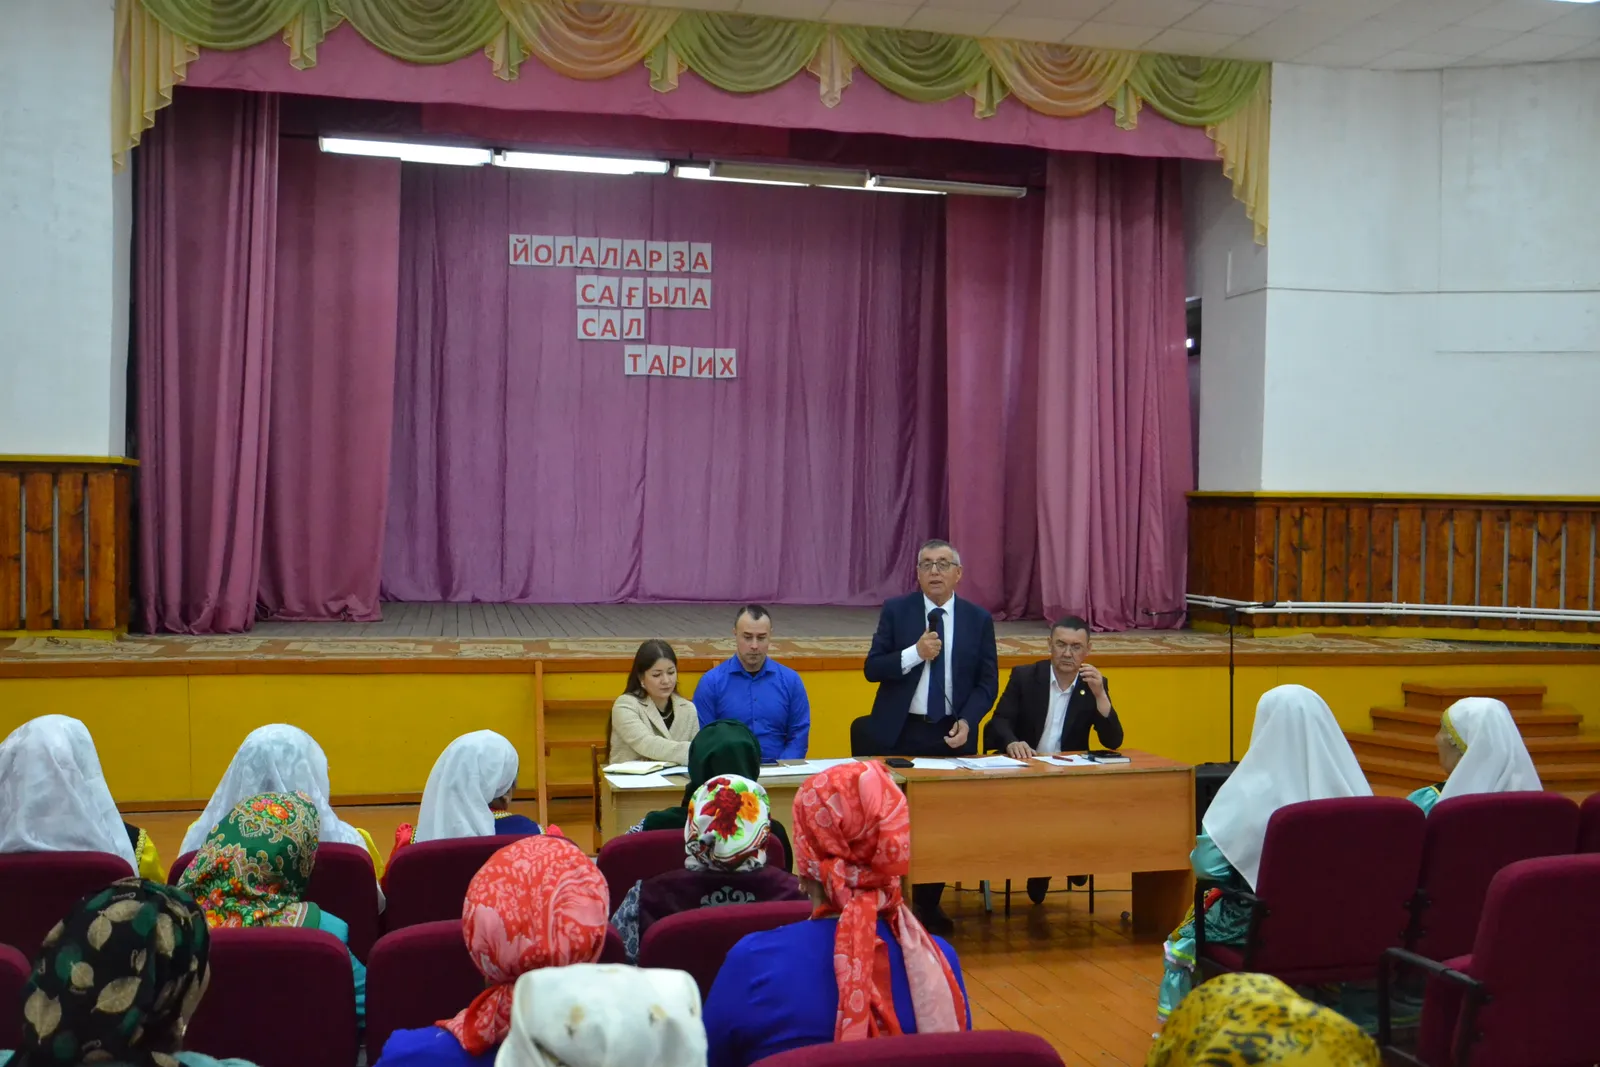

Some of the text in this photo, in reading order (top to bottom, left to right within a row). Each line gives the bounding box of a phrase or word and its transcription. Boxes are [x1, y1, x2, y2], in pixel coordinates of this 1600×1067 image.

[512, 238, 709, 272] ЙОЛАЛАРҘА
[580, 284, 708, 306] САҒЫЛА
[582, 318, 642, 337] САЛ
[627, 353, 735, 376] ТАРИХ
